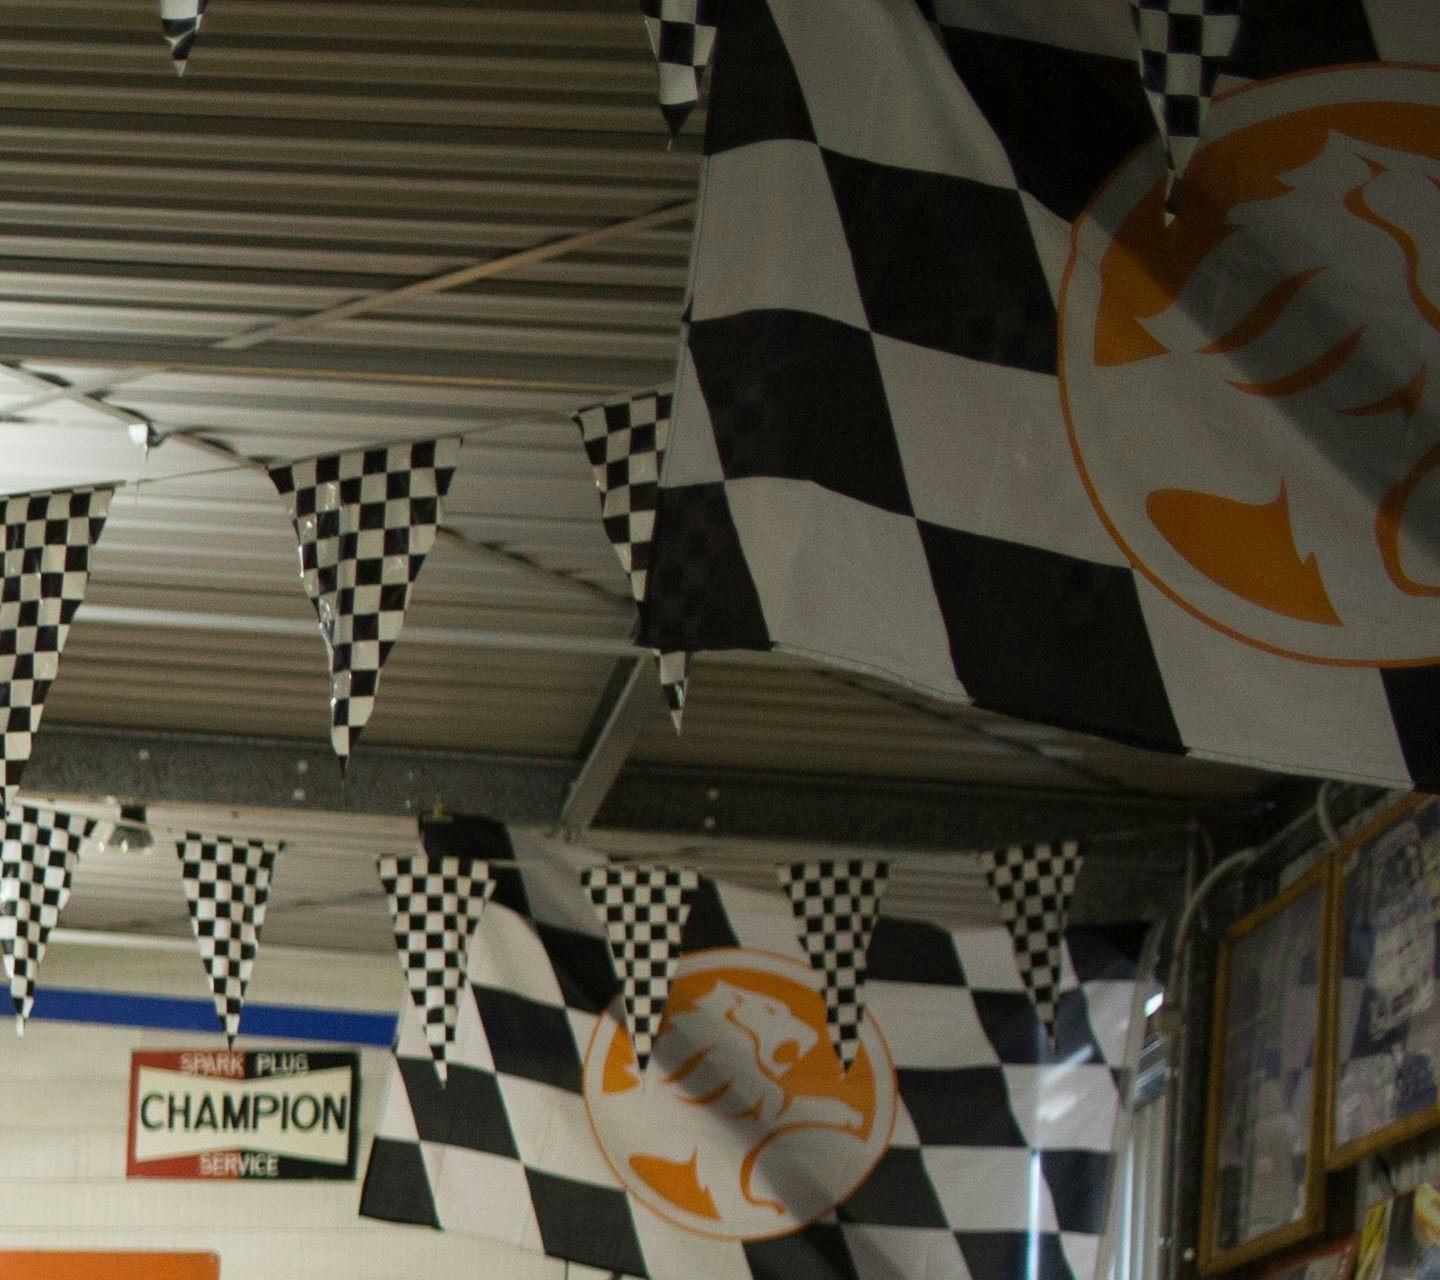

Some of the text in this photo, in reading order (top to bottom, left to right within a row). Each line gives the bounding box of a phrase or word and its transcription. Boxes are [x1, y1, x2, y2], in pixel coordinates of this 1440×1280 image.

[180, 1053, 309, 1075] SPARK PLUG
[139, 1091, 347, 1132] CHAMPION
[198, 1152, 280, 1177] SERVICE
